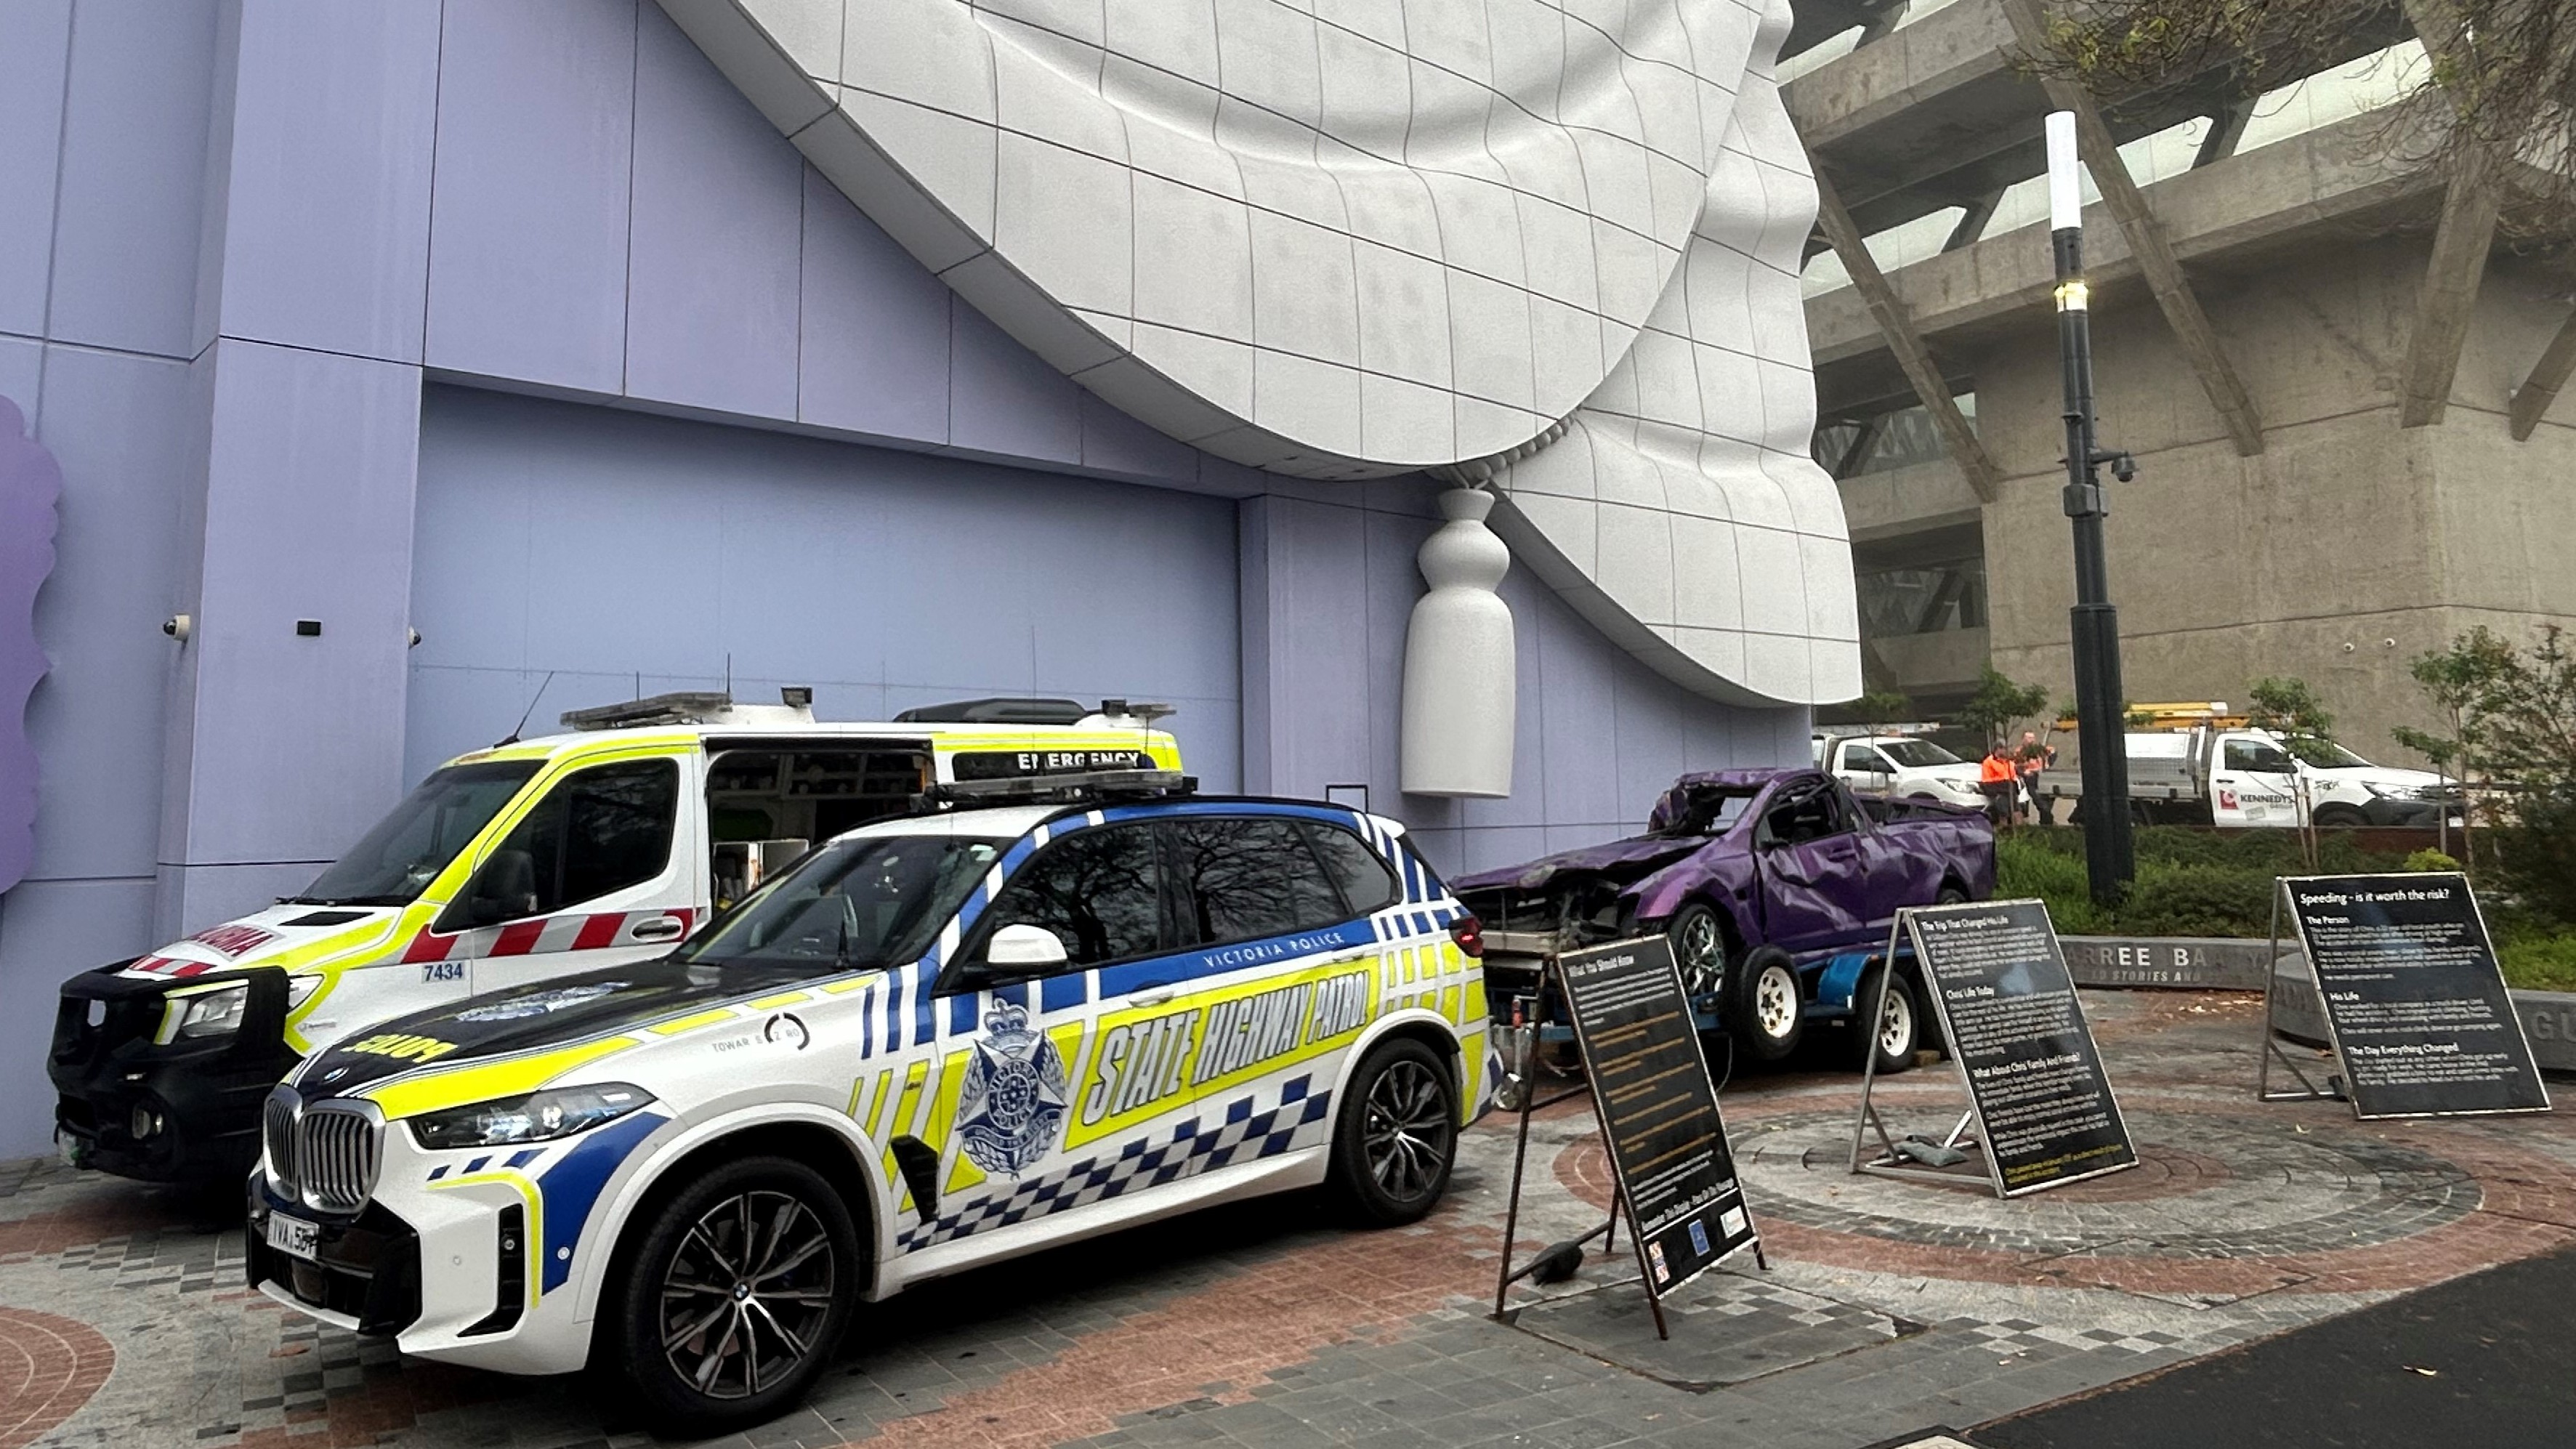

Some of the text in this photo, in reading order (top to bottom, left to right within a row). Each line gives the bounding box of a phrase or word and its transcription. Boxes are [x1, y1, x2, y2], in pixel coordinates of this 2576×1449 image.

[2300, 892, 2347, 906] Speeding
[2355, 892, 2364, 902] is
[2365, 892, 2373, 902] it
[2375, 890, 2407, 901] worth
[2407, 889, 2426, 900] the
[2427, 888, 2450, 900] risk?
[2306, 916, 2322, 925] The
[1203, 932, 1345, 968] VICTORIA POLICE
[424, 963, 463, 982] 7434
[712, 1028, 800, 1053] TOWARS ZRO
[1081, 969, 1370, 1126] STATE HIGHWAY PATROL
[2347, 1042, 2459, 1057] The Day Everything Changed
